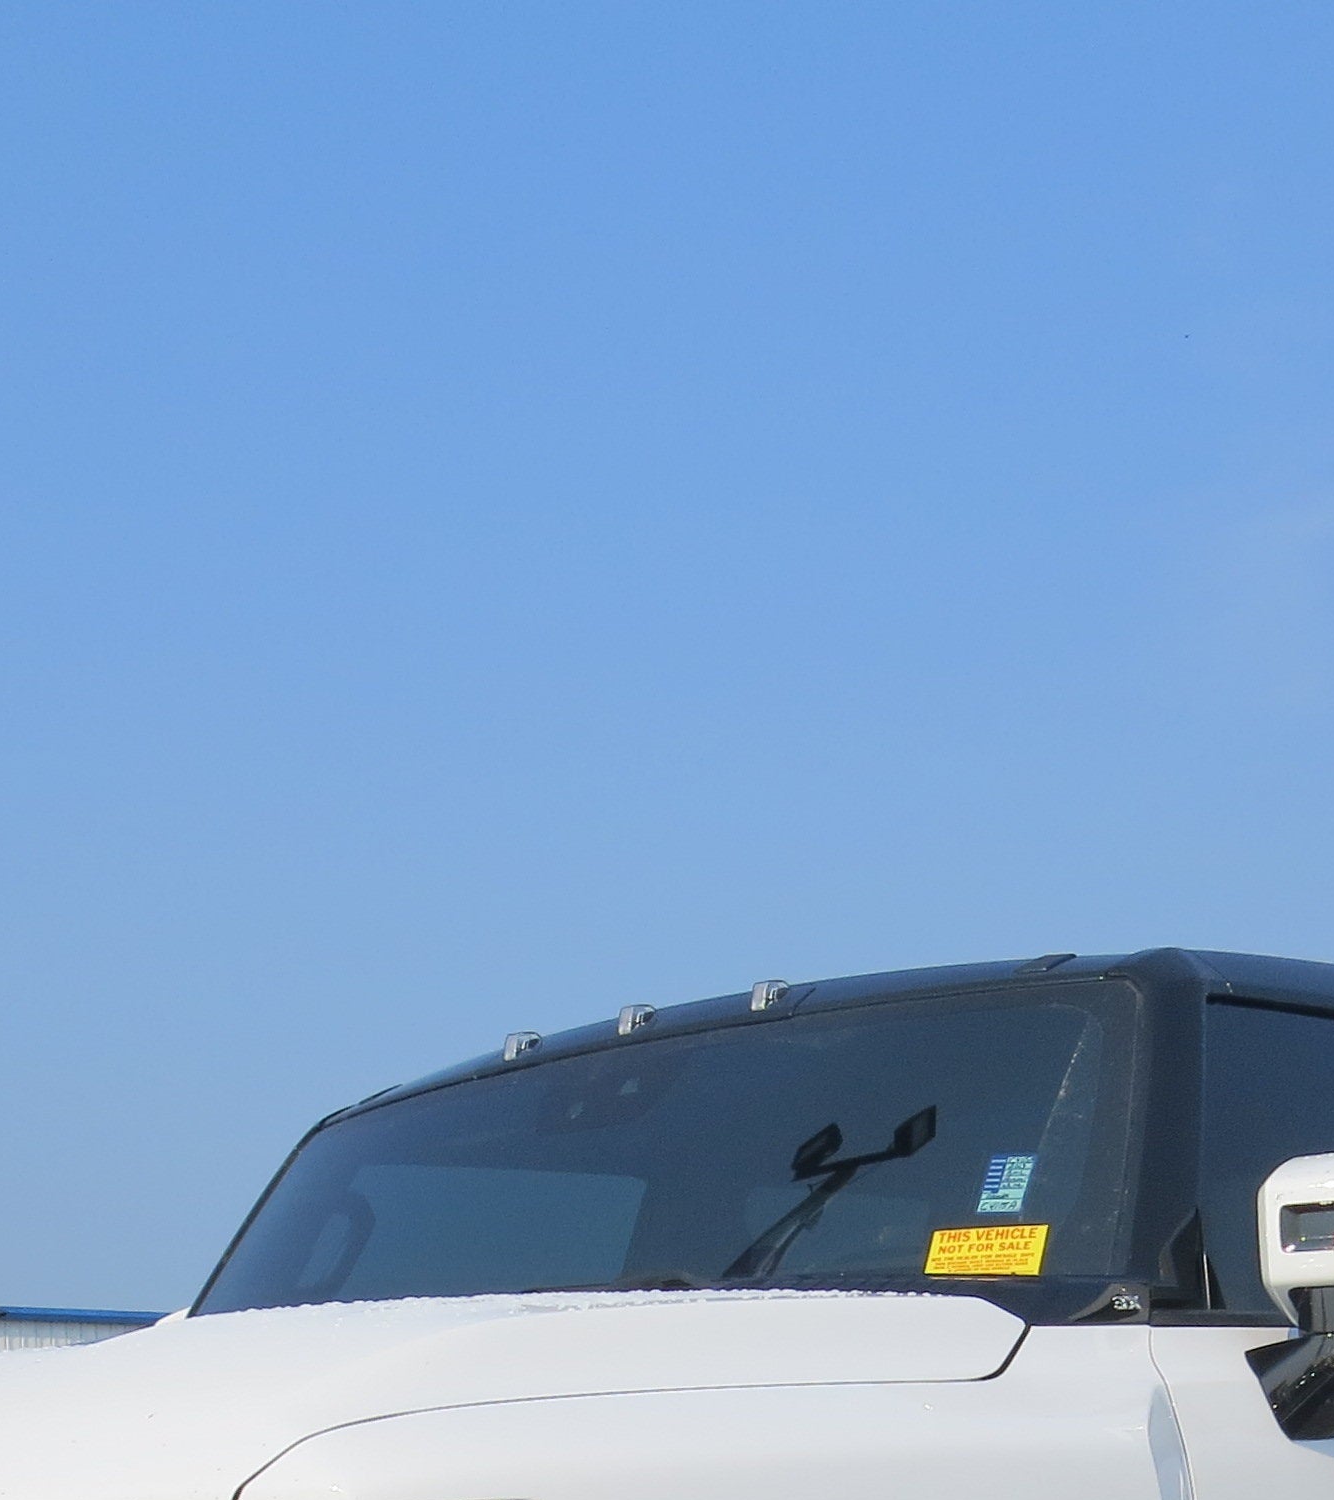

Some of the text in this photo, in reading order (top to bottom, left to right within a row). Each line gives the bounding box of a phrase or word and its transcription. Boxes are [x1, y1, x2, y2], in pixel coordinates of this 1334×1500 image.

[939, 1227, 1038, 1244] THIS VEHICLE
[938, 1241, 1032, 1255] NOT FOR SALE
